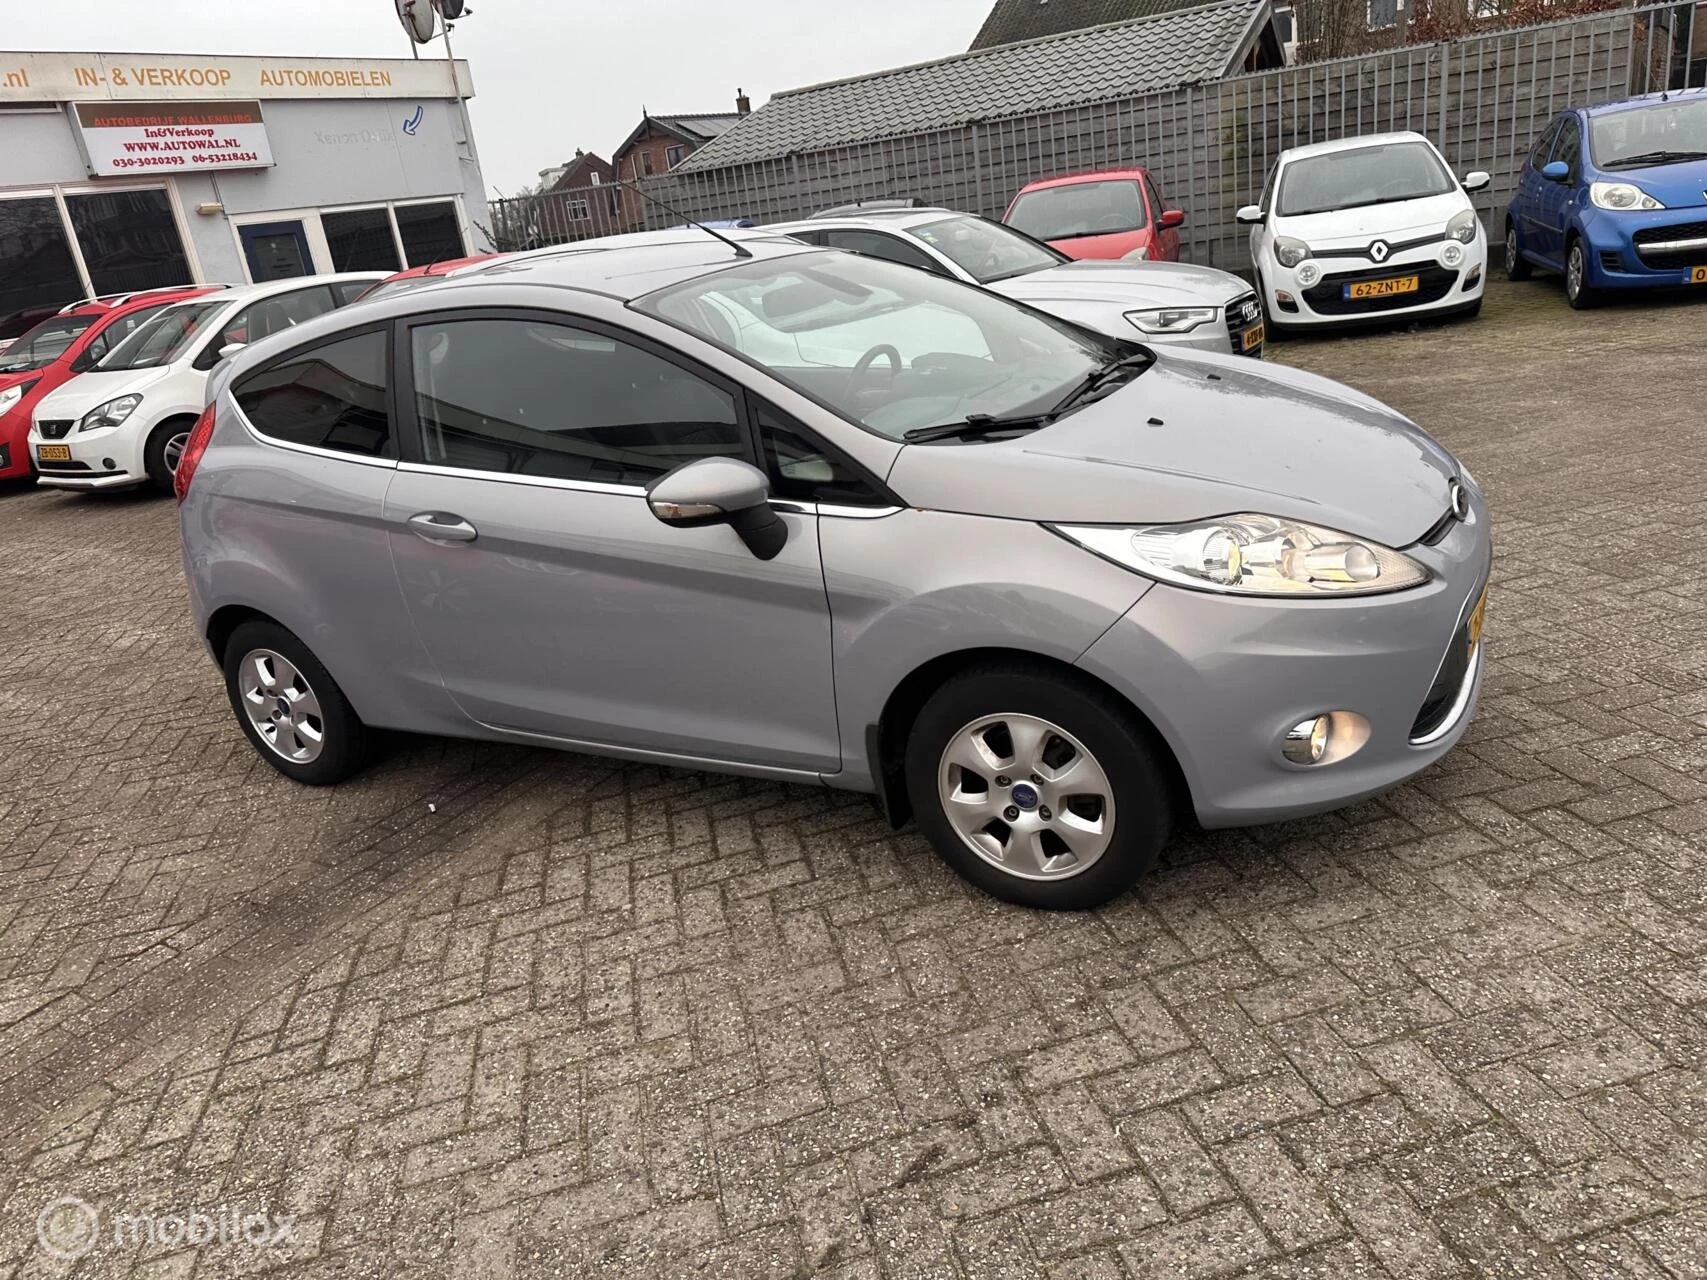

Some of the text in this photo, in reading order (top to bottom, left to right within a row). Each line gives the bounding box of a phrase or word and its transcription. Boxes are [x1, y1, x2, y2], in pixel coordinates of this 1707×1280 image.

[3, 67, 392, 87] .nl IN- & VERKOOP AUTOMOBIELEN
[94, 114, 253, 127] AUTOBEDRIJF WALLENBURG
[144, 127, 215, 138] In&Verkoop
[123, 138, 241, 153] WWW.AUTOWAL.NL
[112, 151, 258, 168] 030-3020293 06-53218434
[1355, 278, 1414, 297] 62-ZNT-7
